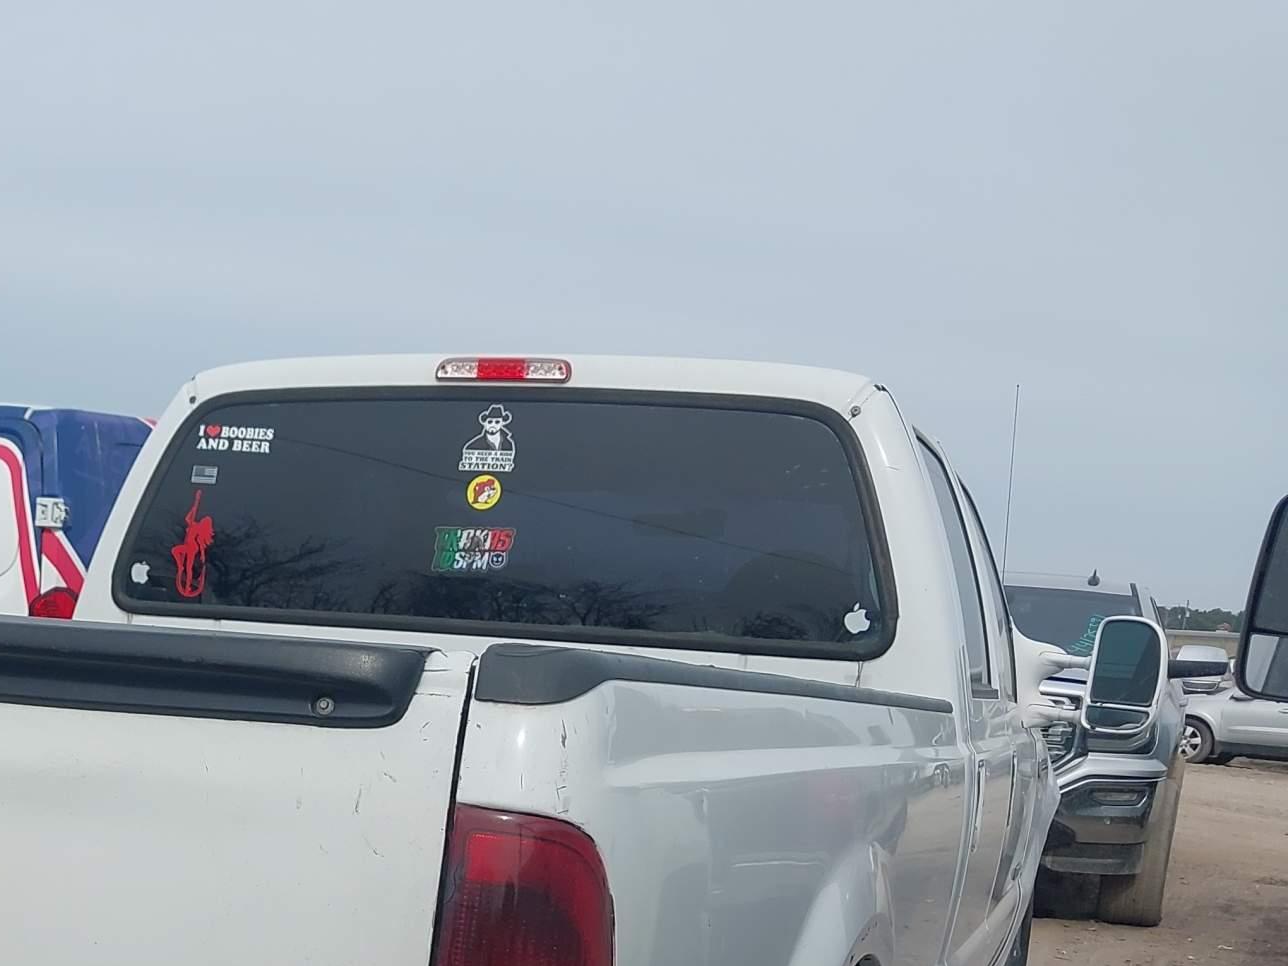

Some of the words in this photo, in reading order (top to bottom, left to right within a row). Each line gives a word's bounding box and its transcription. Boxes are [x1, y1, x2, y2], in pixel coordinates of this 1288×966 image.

[198, 424, 207, 437] I
[220, 426, 274, 441] BOOBIES
[196, 438, 230, 450] AND
[231, 439, 271, 454] BEER
[460, 462, 513, 471] STATION?
